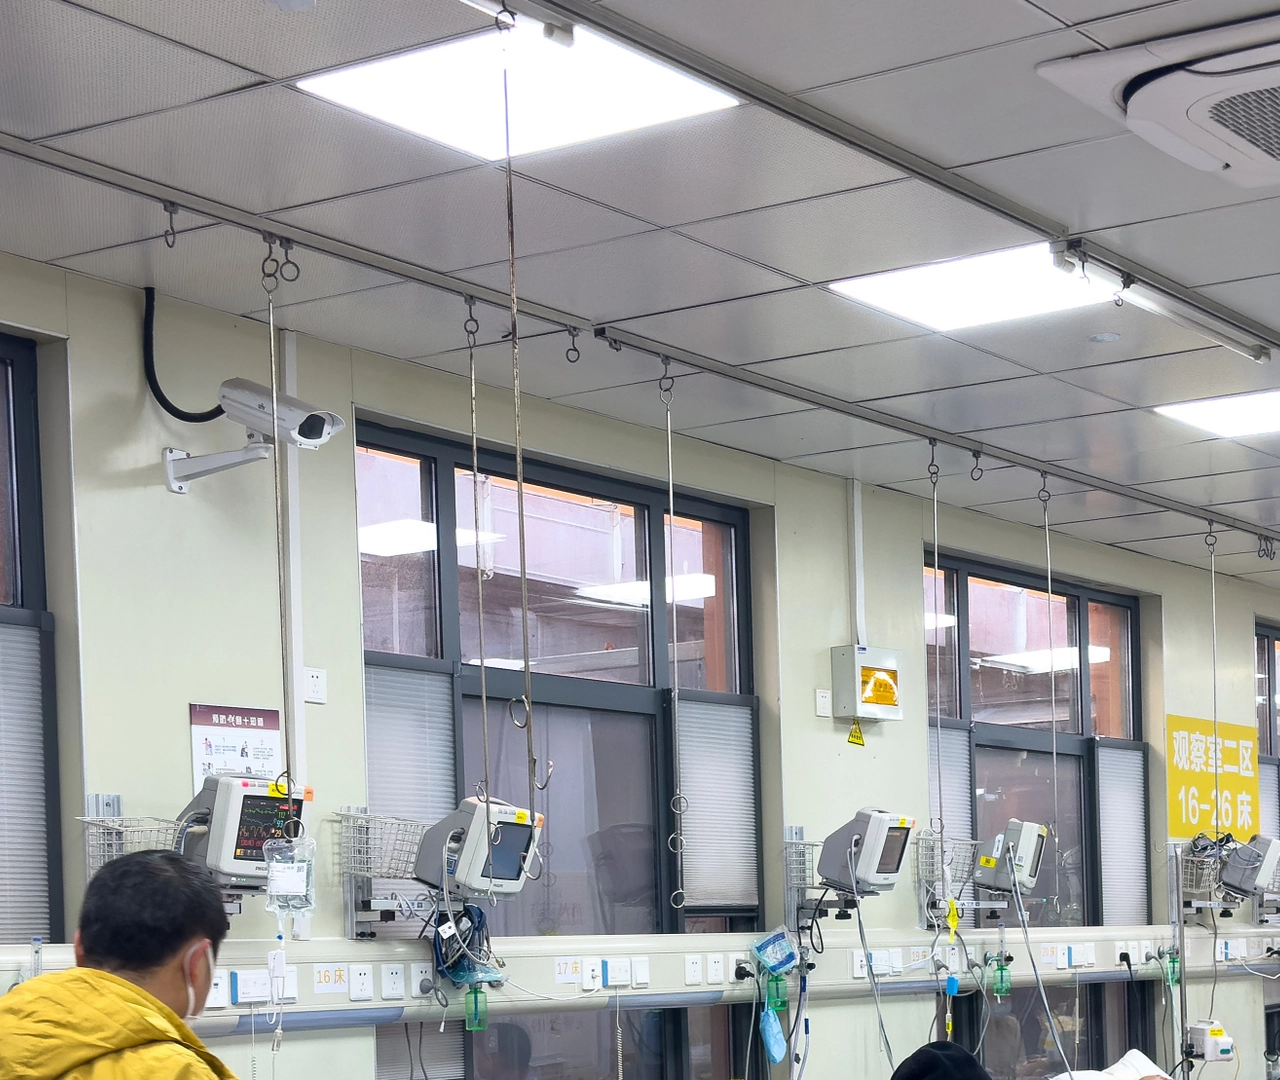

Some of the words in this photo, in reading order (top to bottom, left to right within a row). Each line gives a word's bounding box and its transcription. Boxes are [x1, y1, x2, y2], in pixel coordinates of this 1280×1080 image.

[1172, 730, 1255, 778] 观察室二区
